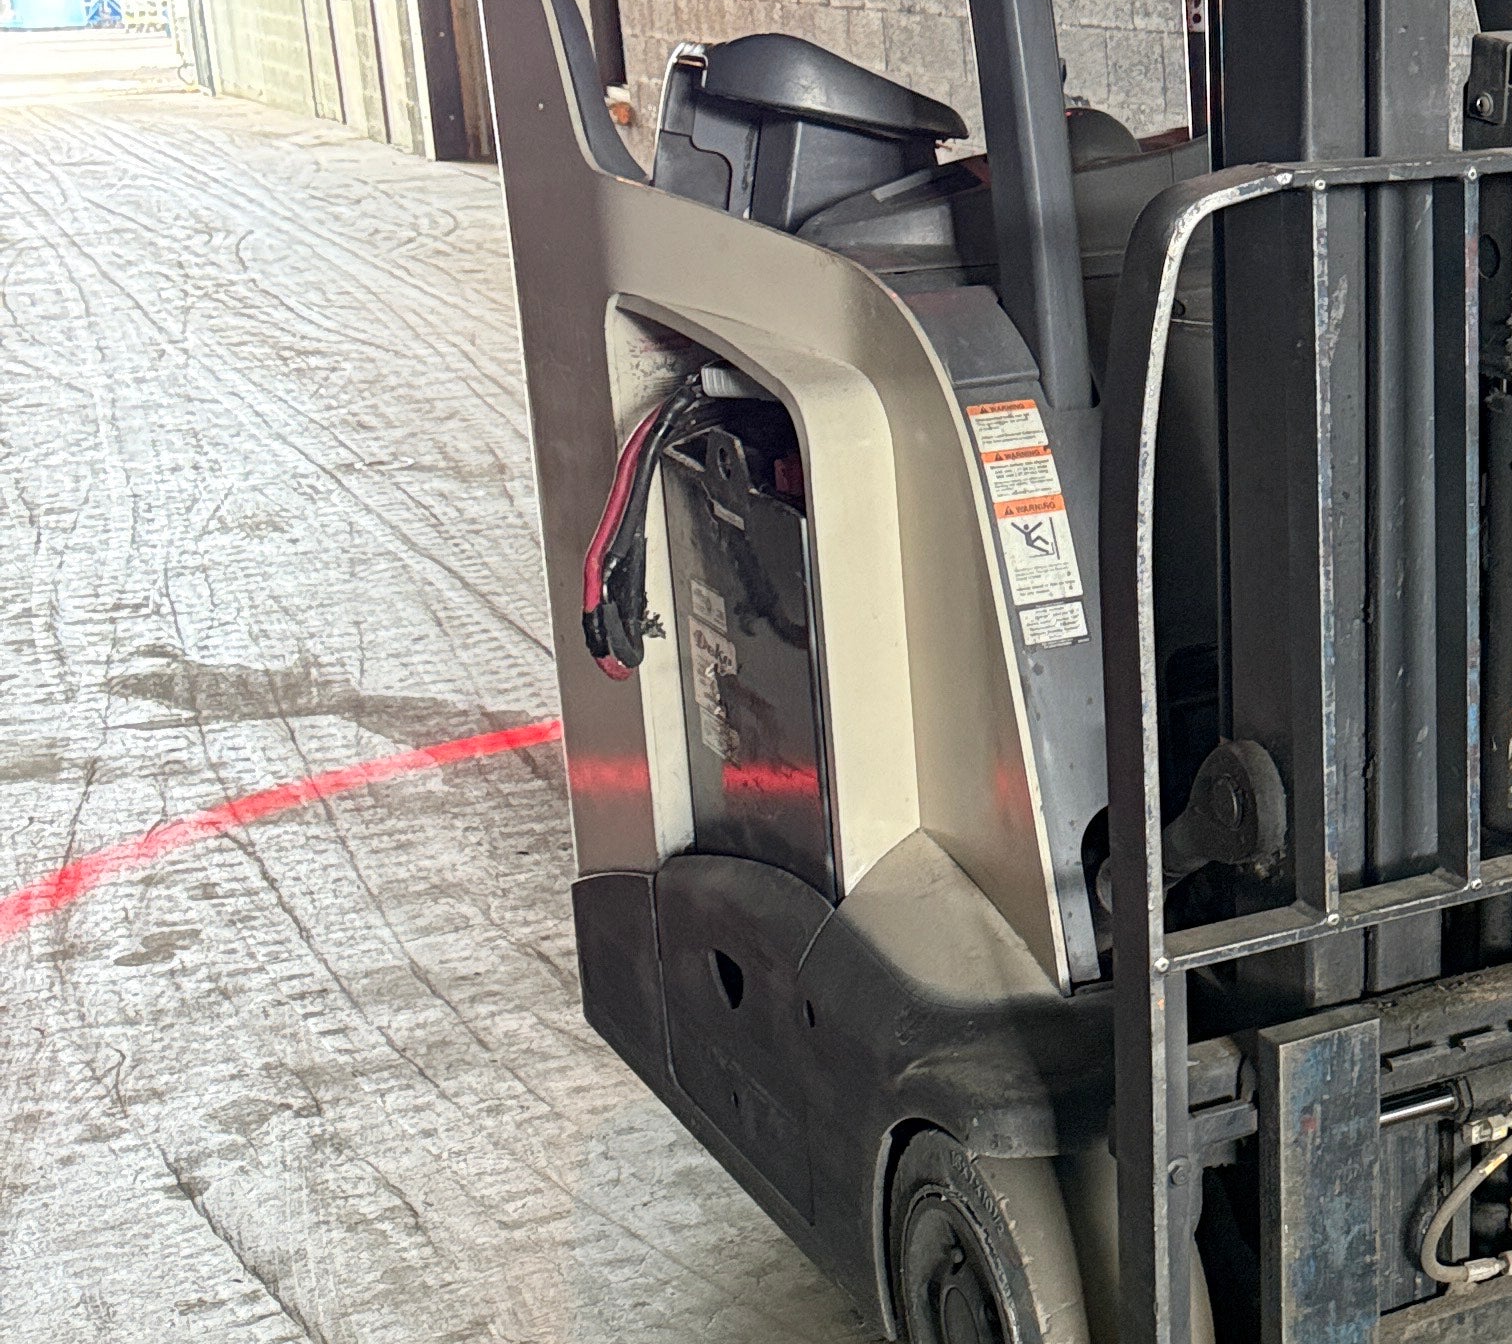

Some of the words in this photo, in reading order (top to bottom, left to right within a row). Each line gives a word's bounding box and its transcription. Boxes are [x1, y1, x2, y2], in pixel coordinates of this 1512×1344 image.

[989, 403, 1025, 413] WARNING
[1003, 449, 1041, 460] WARNING
[1015, 501, 1056, 514] WARNING
